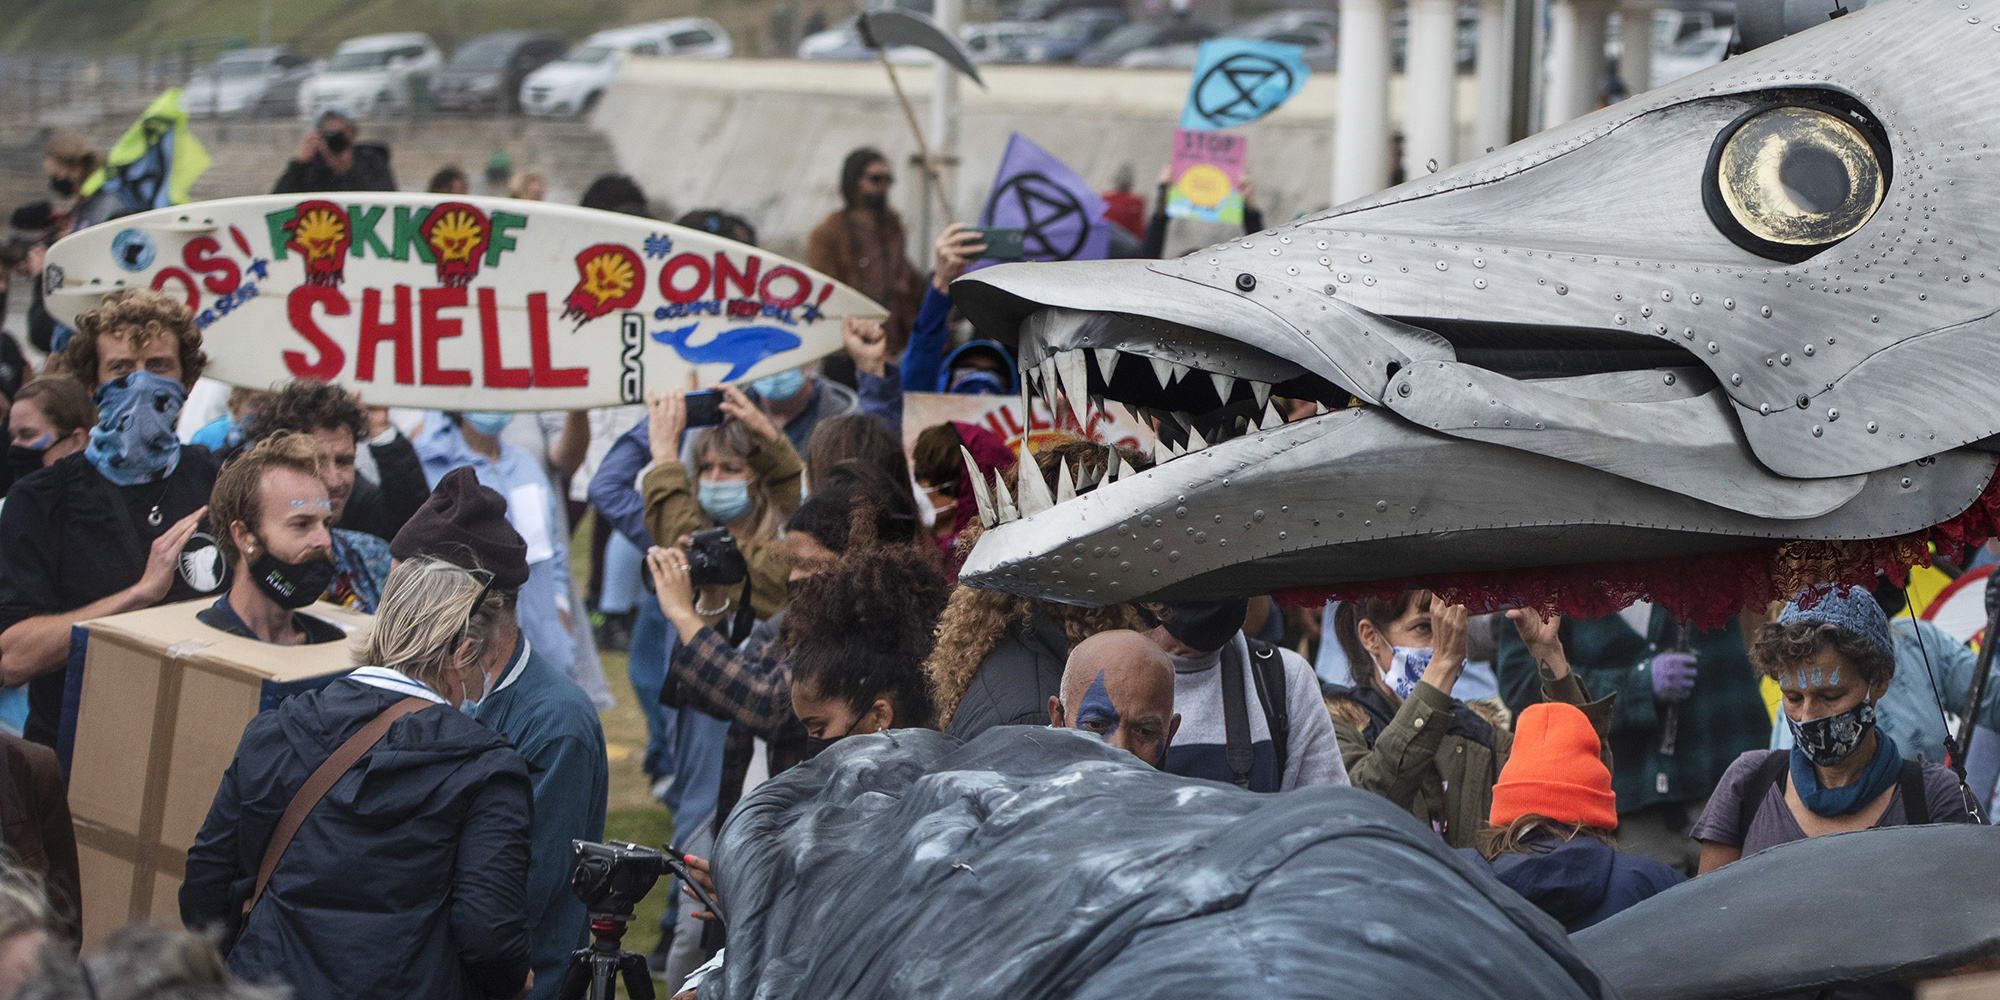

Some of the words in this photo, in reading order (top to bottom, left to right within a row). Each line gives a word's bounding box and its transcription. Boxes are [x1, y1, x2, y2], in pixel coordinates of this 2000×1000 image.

[1183, 131, 1236, 152] STOP
[281, 284, 589, 389] SHELL
[986, 403, 1115, 441] ILLING
